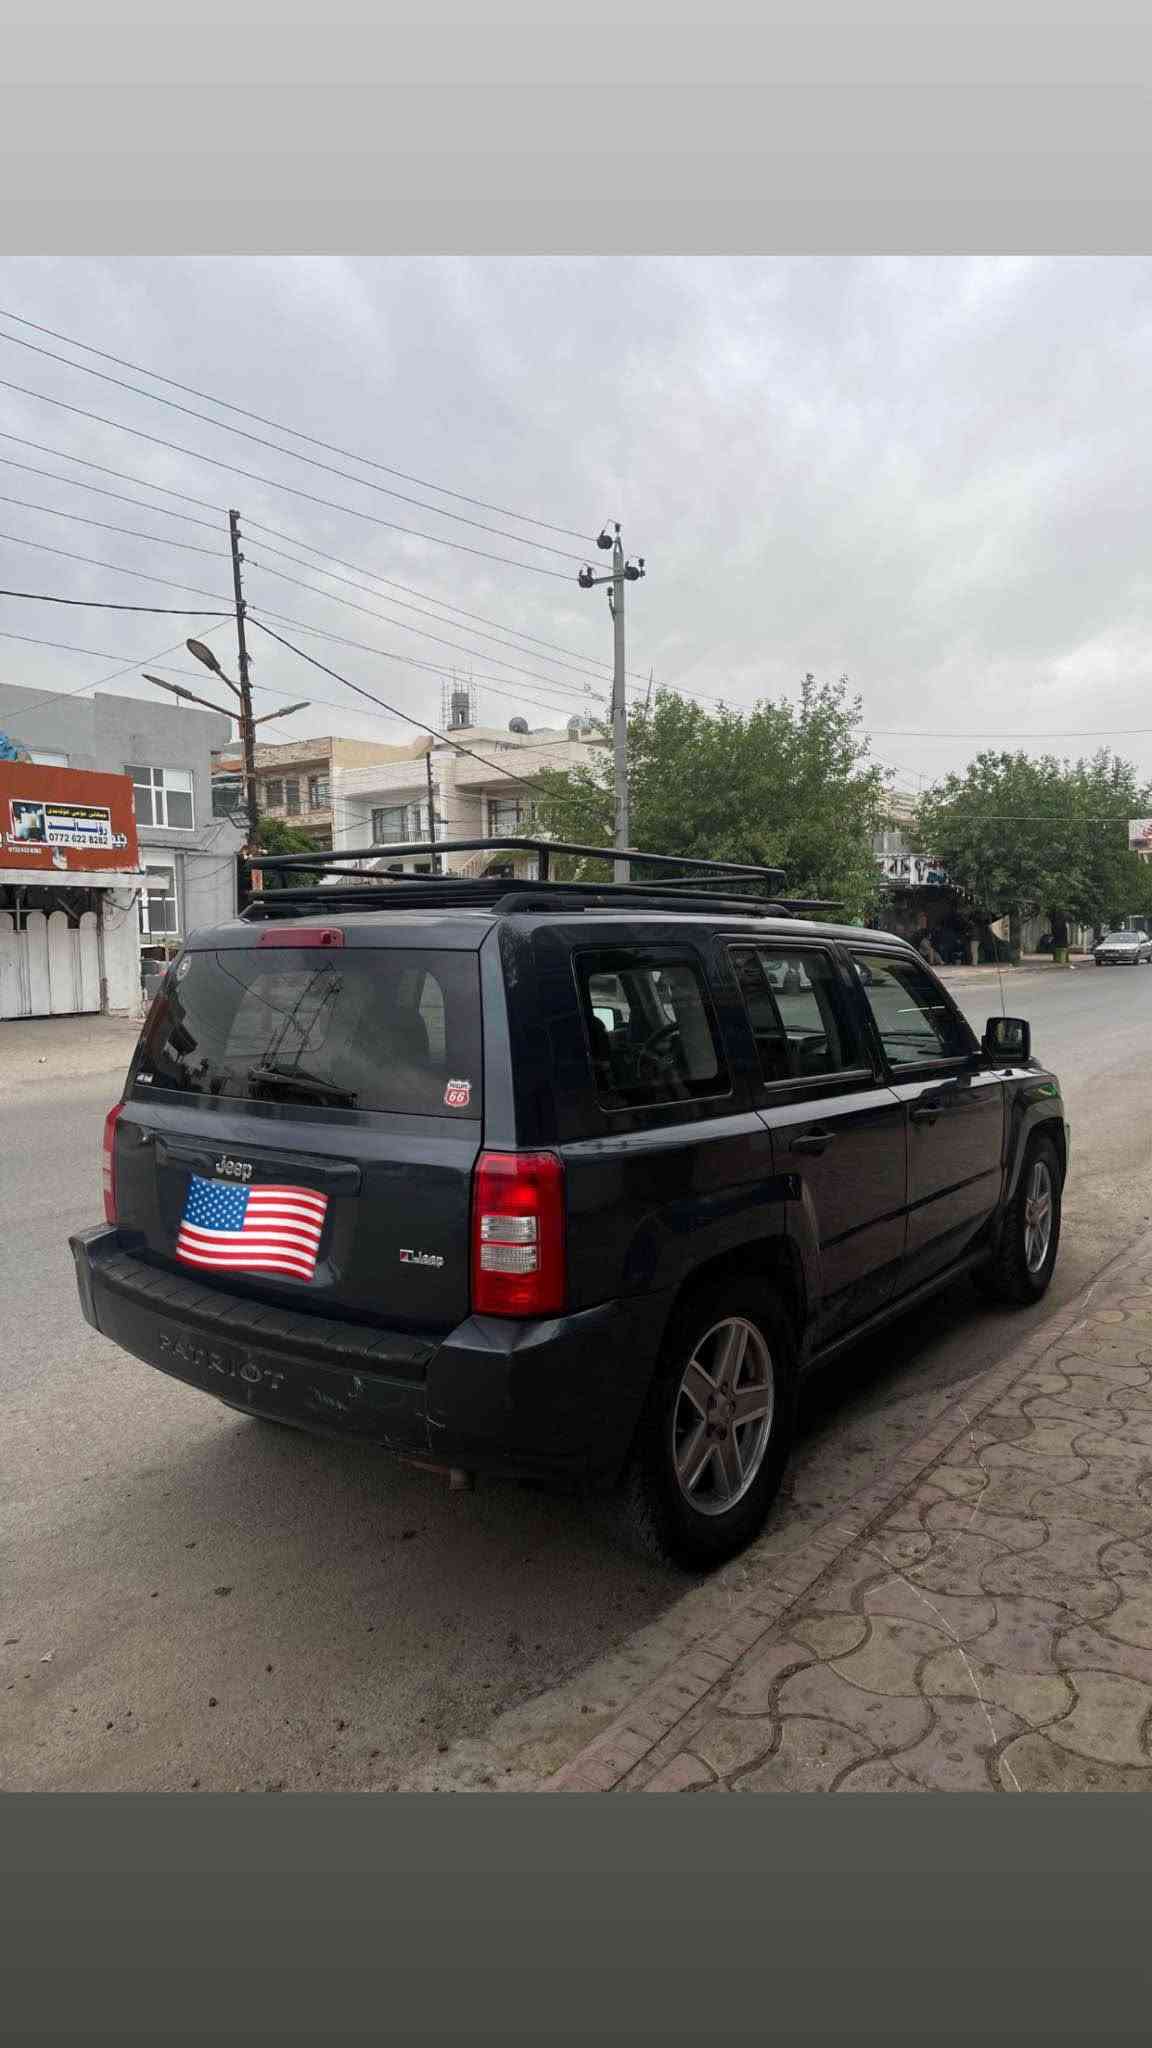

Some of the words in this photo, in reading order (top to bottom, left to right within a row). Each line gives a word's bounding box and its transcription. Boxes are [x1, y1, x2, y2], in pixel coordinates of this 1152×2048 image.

[48, 832, 70, 843] 0772
[89, 835, 109, 846] 8282
[449, 1091, 466, 1103] 66
[215, 1155, 252, 1183] Jeep
[158, 1334, 288, 1391] PATRIOT
